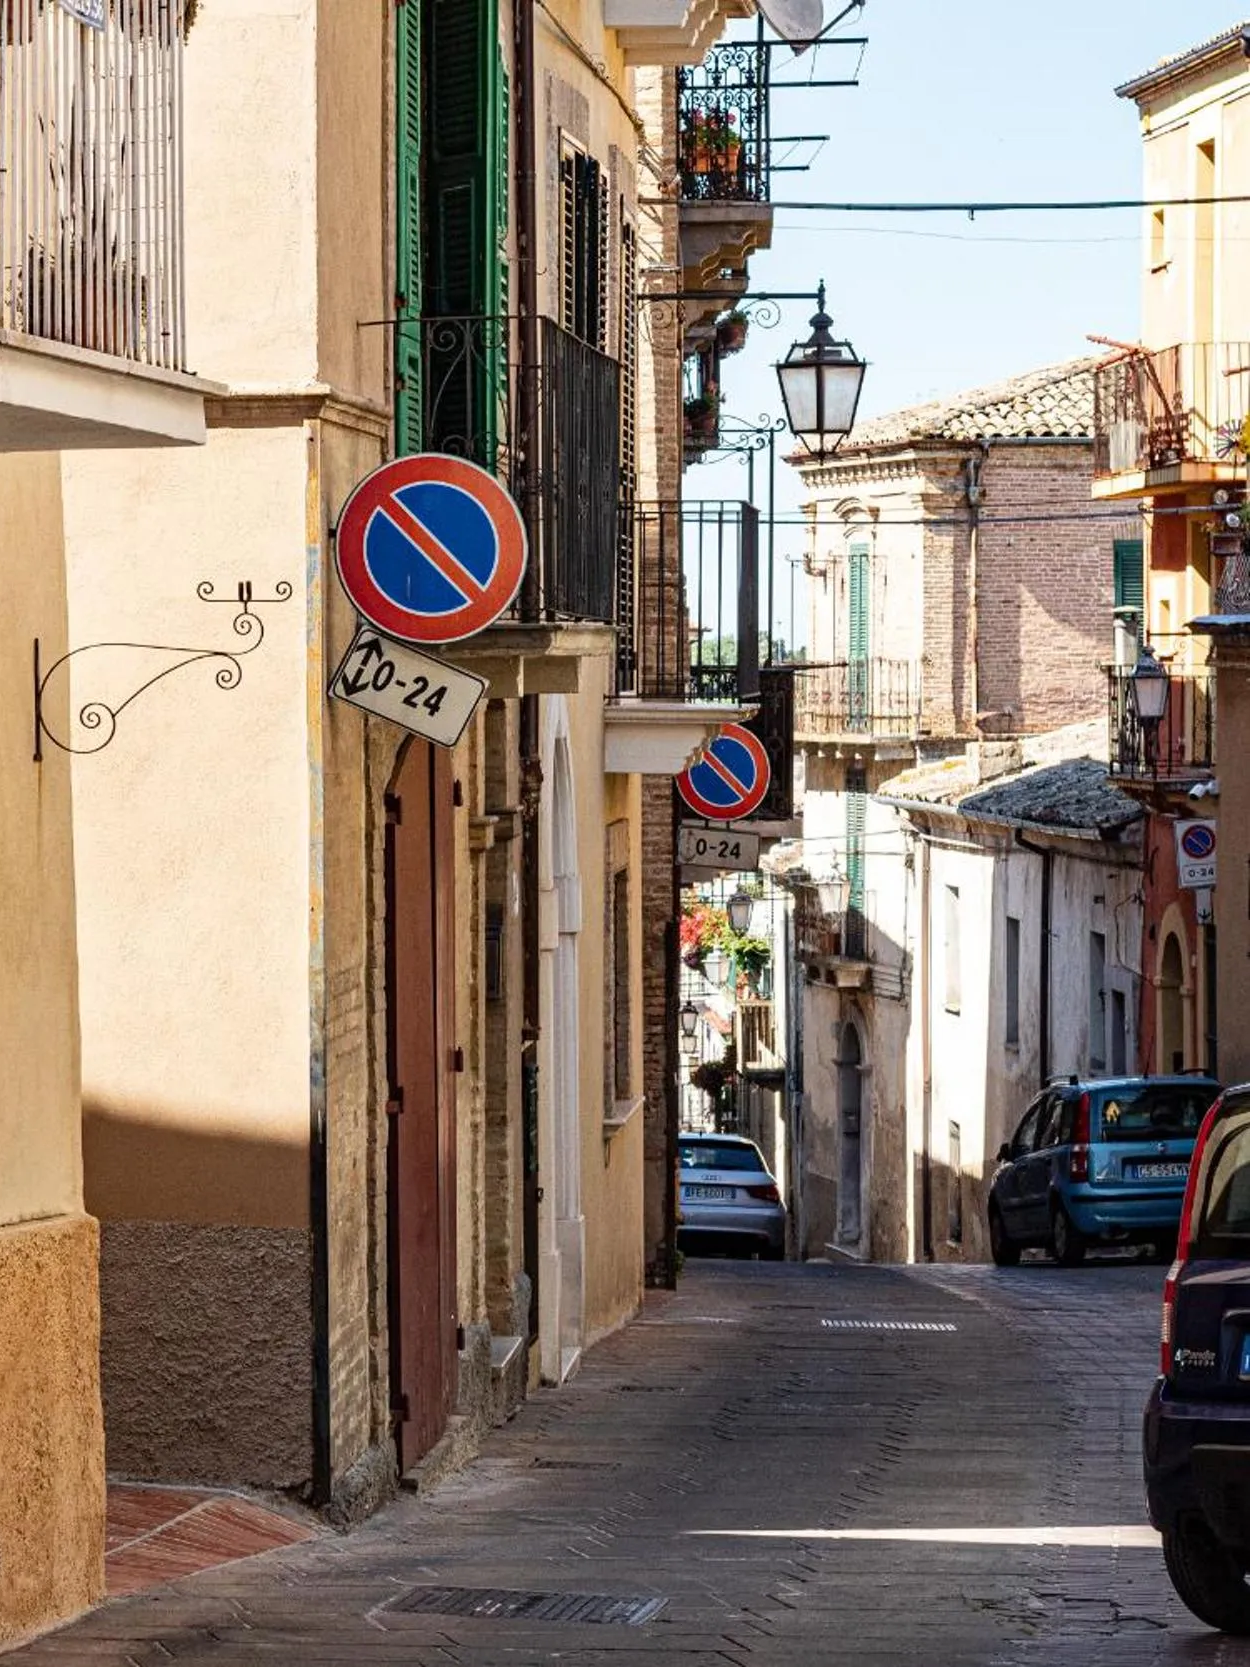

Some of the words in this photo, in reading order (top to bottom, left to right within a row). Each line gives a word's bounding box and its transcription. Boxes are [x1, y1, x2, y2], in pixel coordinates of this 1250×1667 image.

[371, 660, 448, 717] 0-24
[696, 838, 741, 859] 0-24
[1188, 867, 1214, 878] 0-24
